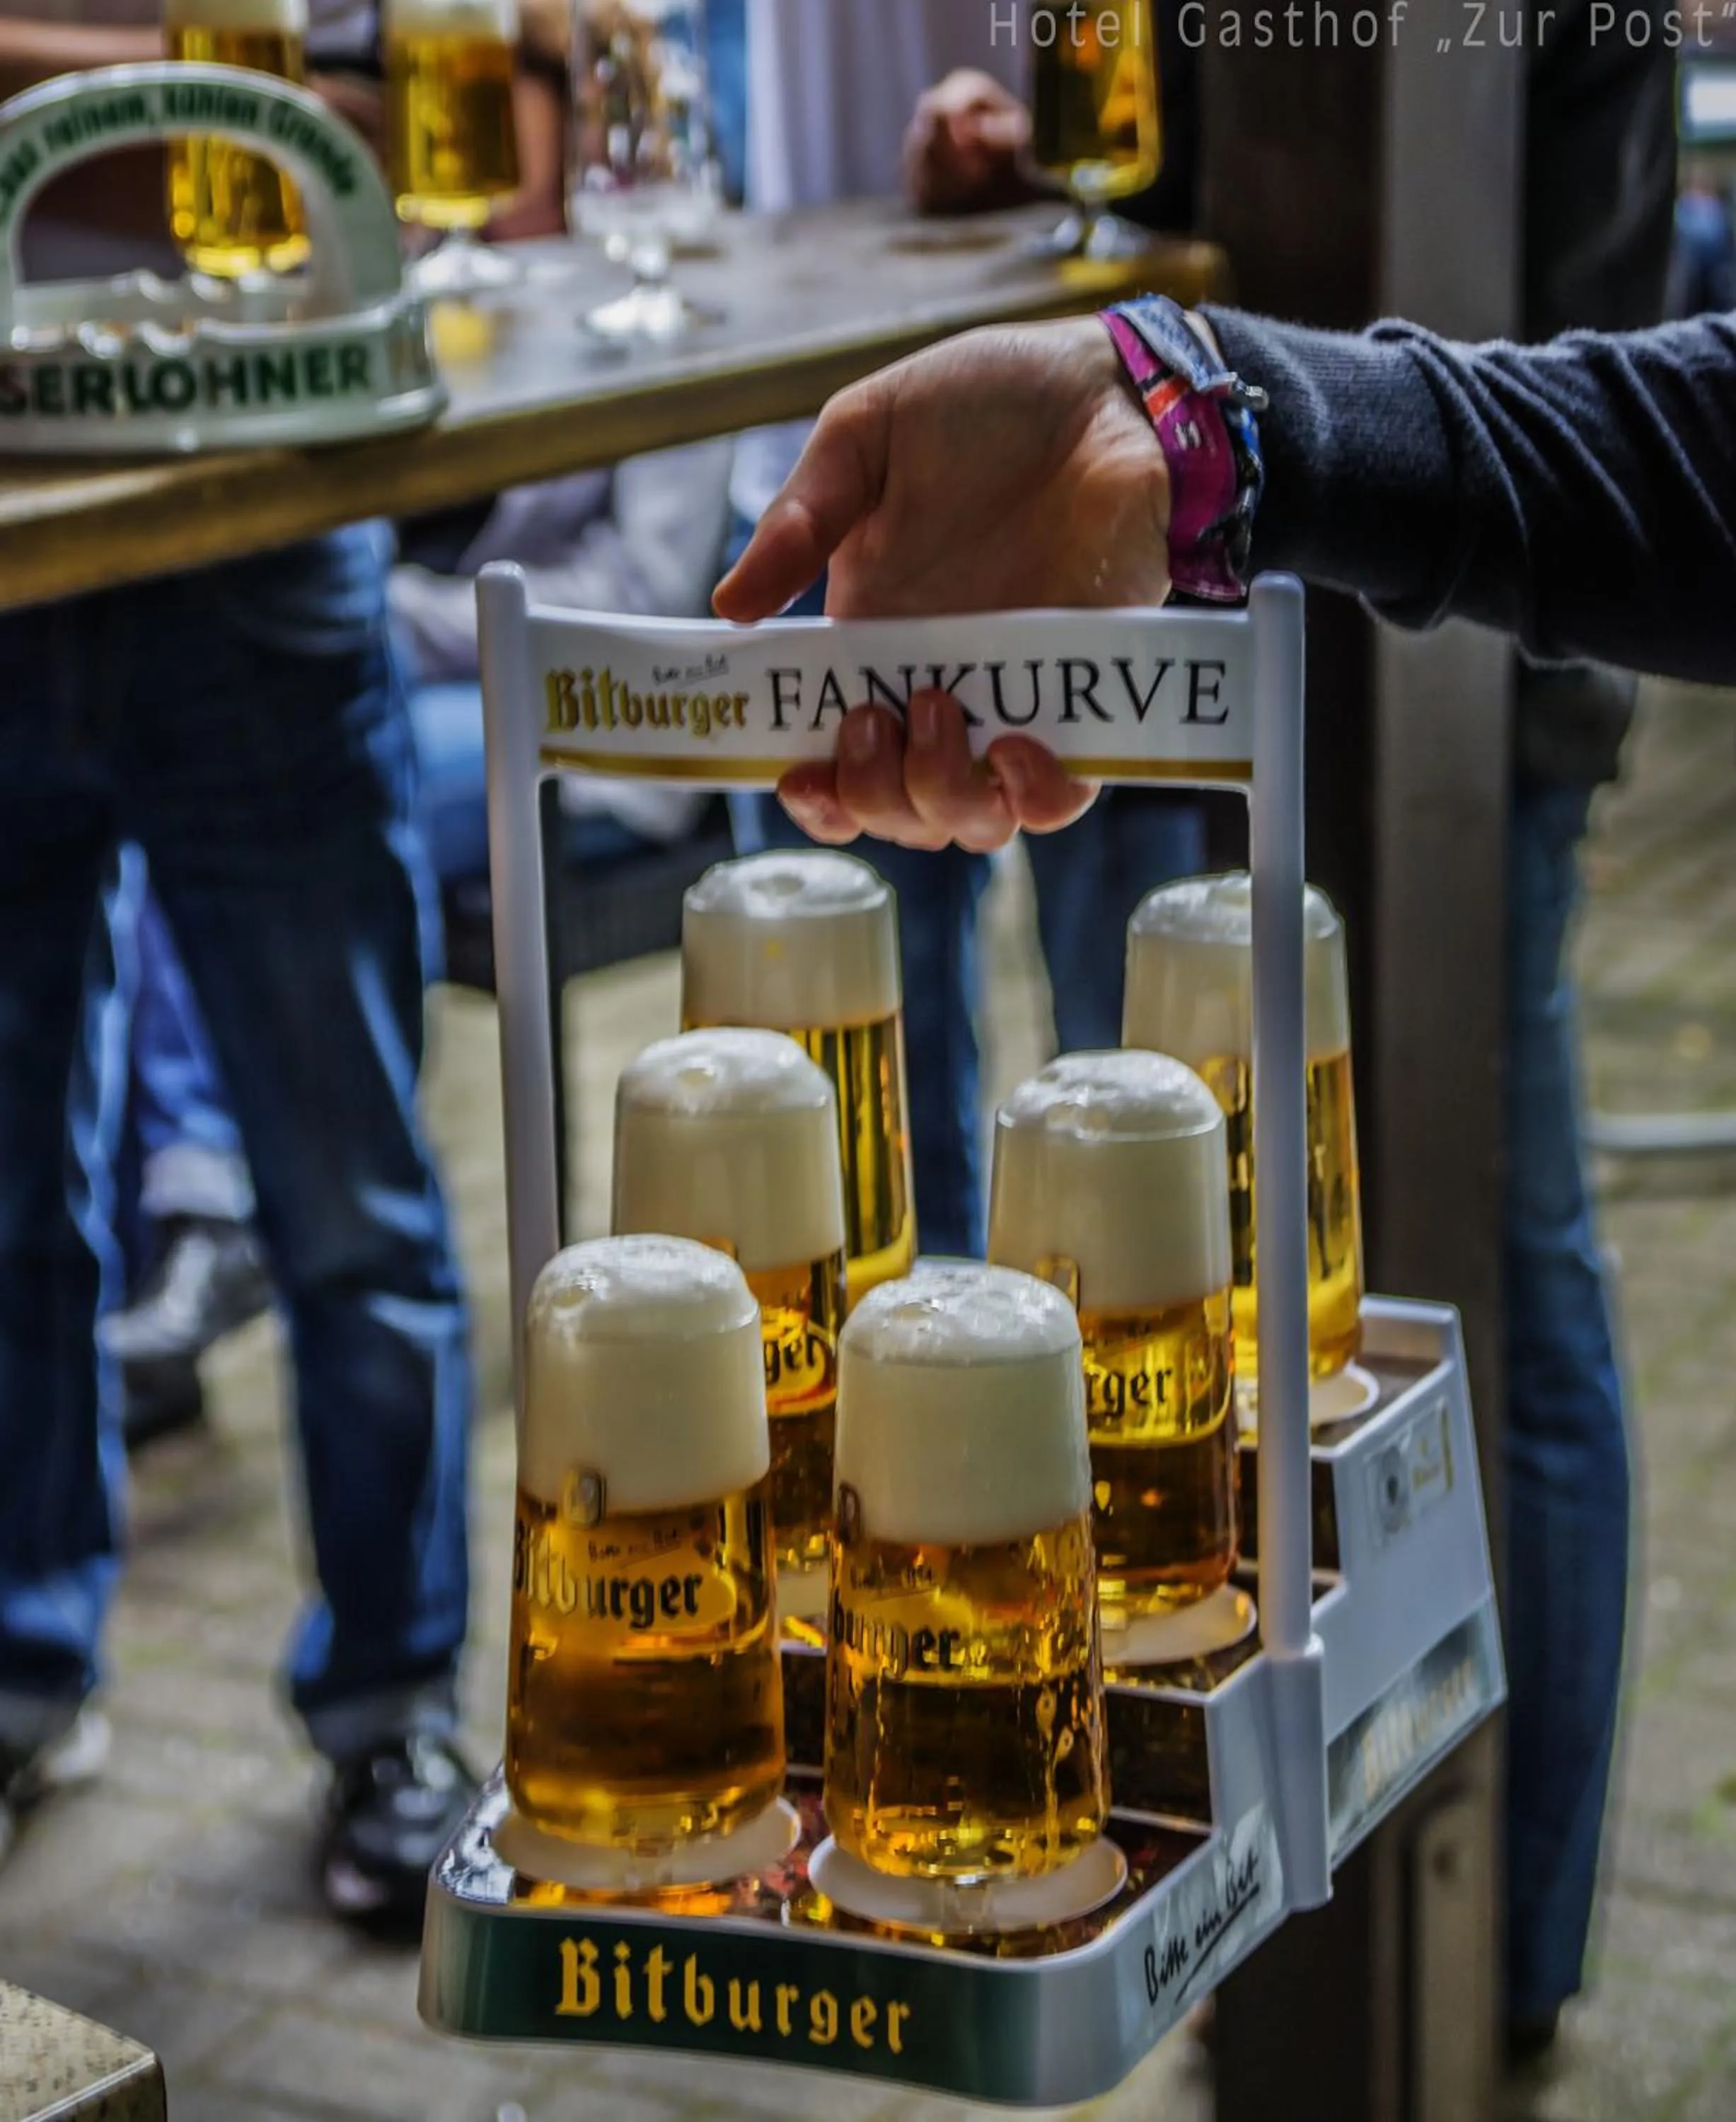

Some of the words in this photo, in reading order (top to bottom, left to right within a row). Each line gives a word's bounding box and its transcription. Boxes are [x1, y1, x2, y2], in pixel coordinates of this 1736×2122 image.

[543, 663, 751, 740] Bitburger
[765, 657, 1231, 733] FANKURVE
[554, 1936, 912, 2055] Bitburger
